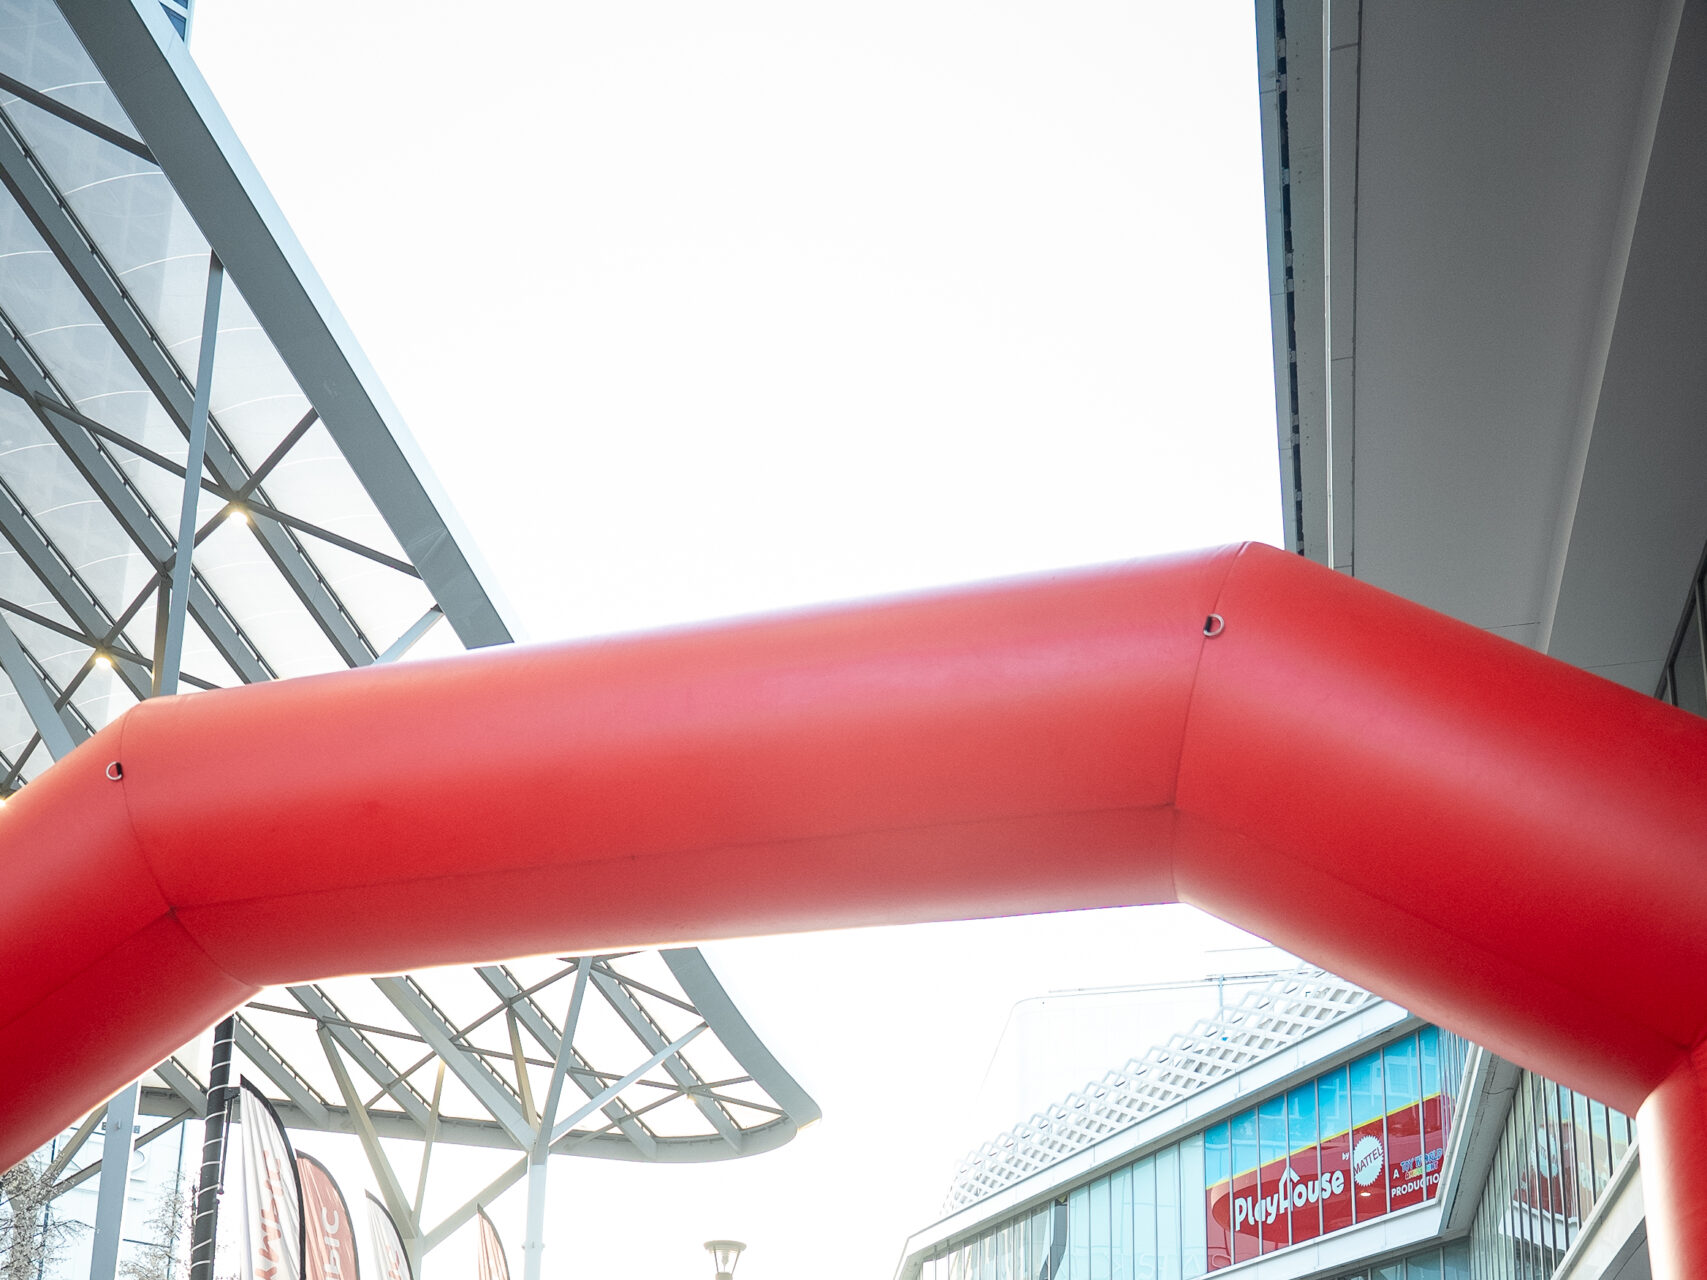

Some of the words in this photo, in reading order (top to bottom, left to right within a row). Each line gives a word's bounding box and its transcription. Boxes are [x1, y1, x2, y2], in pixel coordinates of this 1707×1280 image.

[1353, 1147, 1384, 1176] MATTEL
[1393, 1169, 1400, 1179] A
[1391, 1173, 1441, 1198] PRODUCTIO
